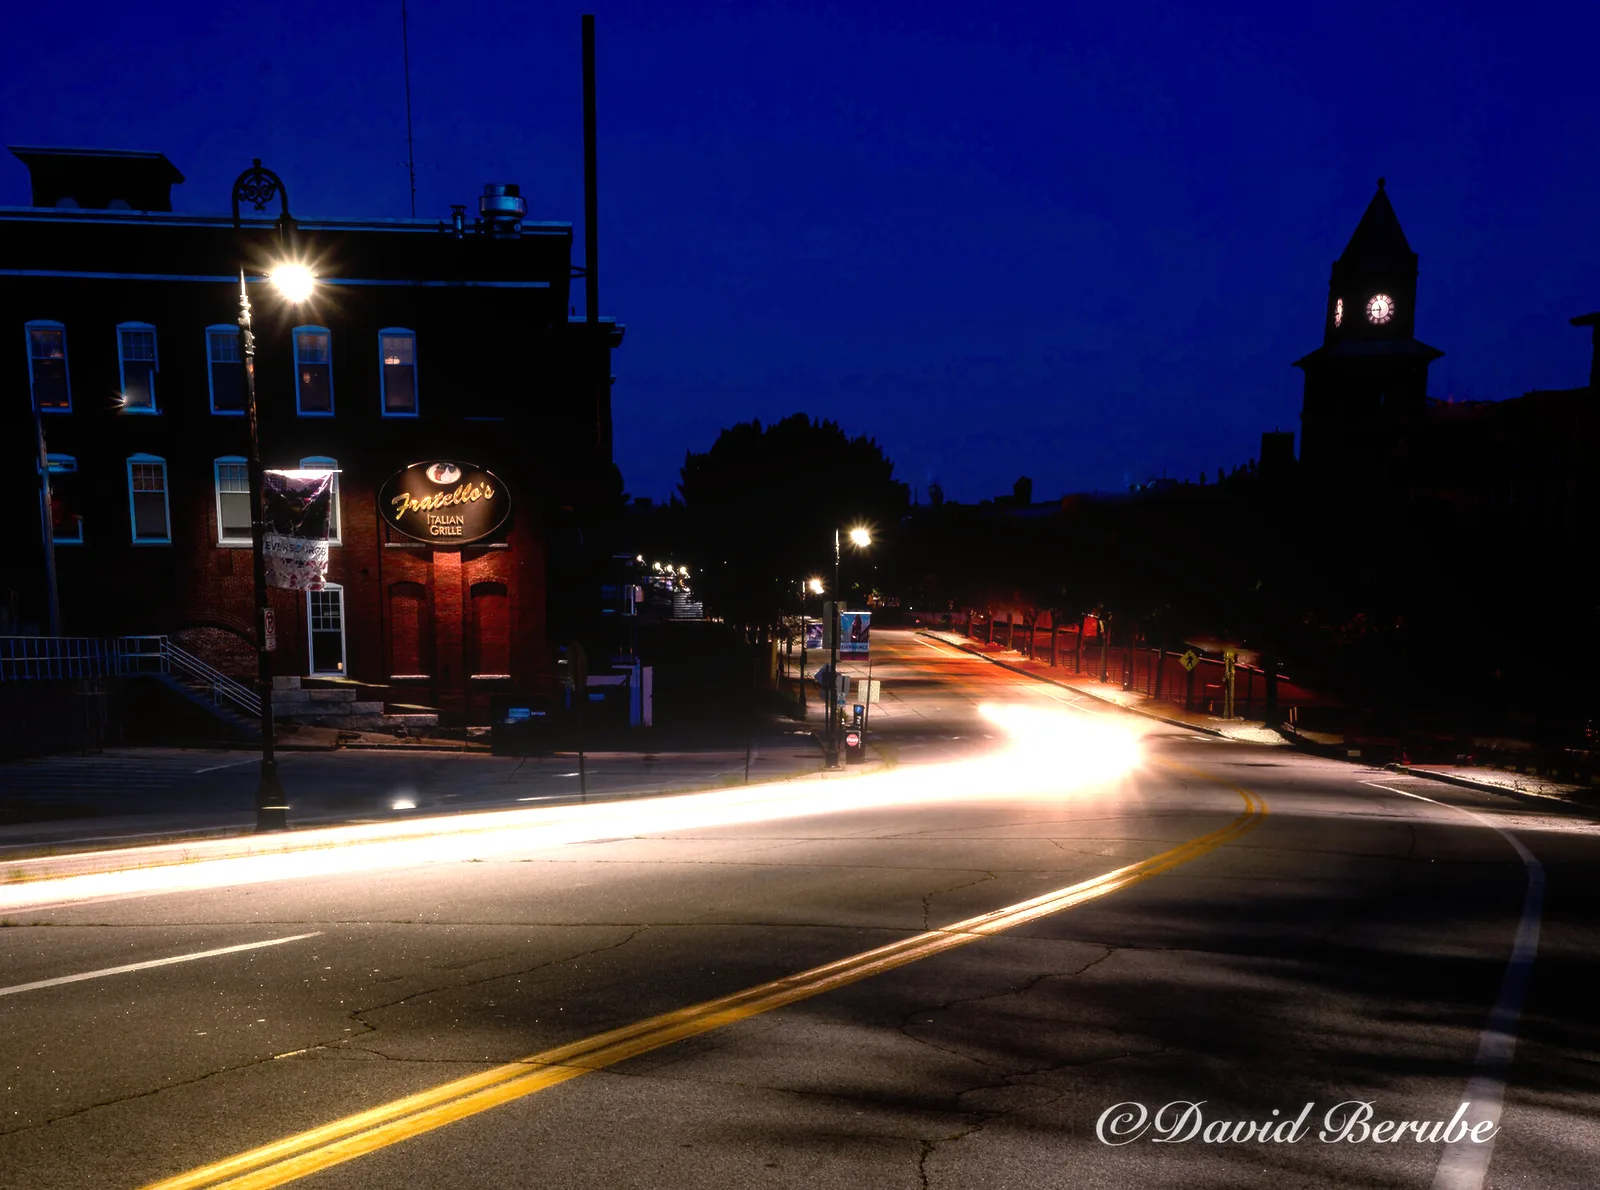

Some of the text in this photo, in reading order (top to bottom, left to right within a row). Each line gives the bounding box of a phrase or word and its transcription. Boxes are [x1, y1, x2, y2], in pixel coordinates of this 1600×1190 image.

[391, 482, 495, 520] Fratello's
[427, 514, 464, 525] ITALIAN
[429, 525, 462, 536] GRILLE
